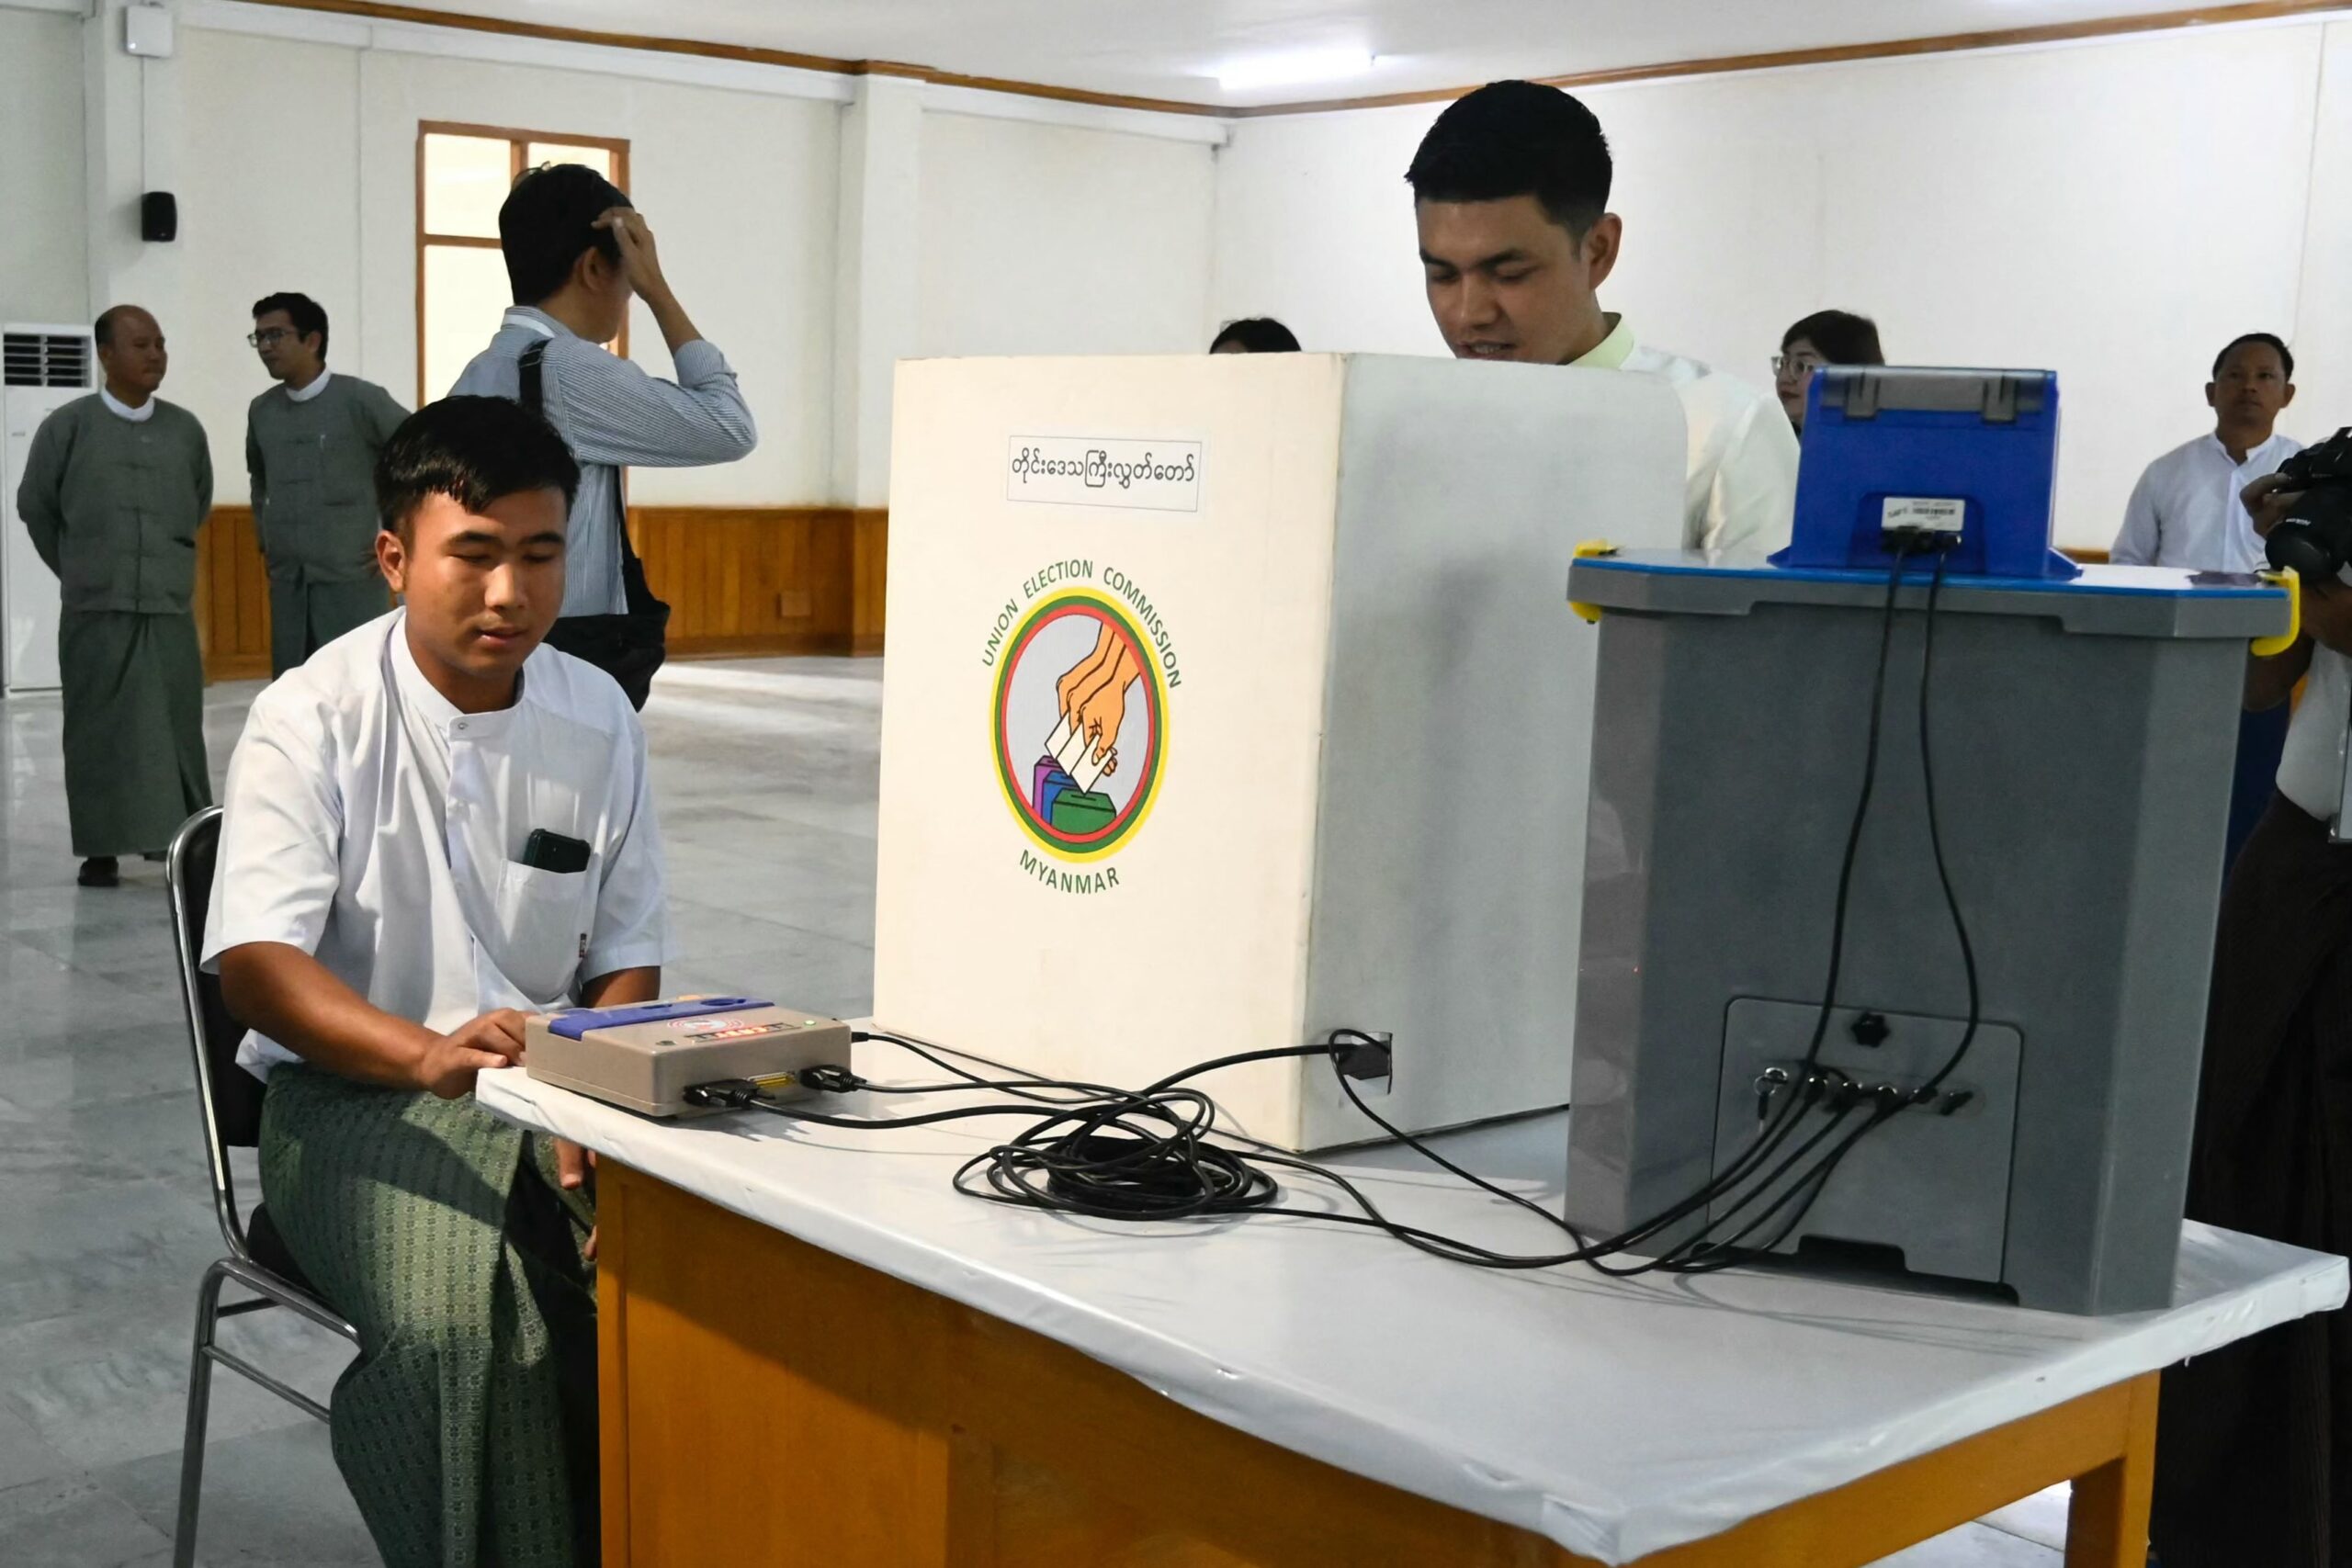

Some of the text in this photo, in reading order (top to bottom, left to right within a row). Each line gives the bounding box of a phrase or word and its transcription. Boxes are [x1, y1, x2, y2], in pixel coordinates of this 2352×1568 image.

[1012, 447, 1194, 489] တိုင်းဒေသကြီးလွှတ်တော်
[982, 559, 1182, 689] UNION ELECTION COMMISSION
[1020, 849, 1119, 894] MYANMAR
